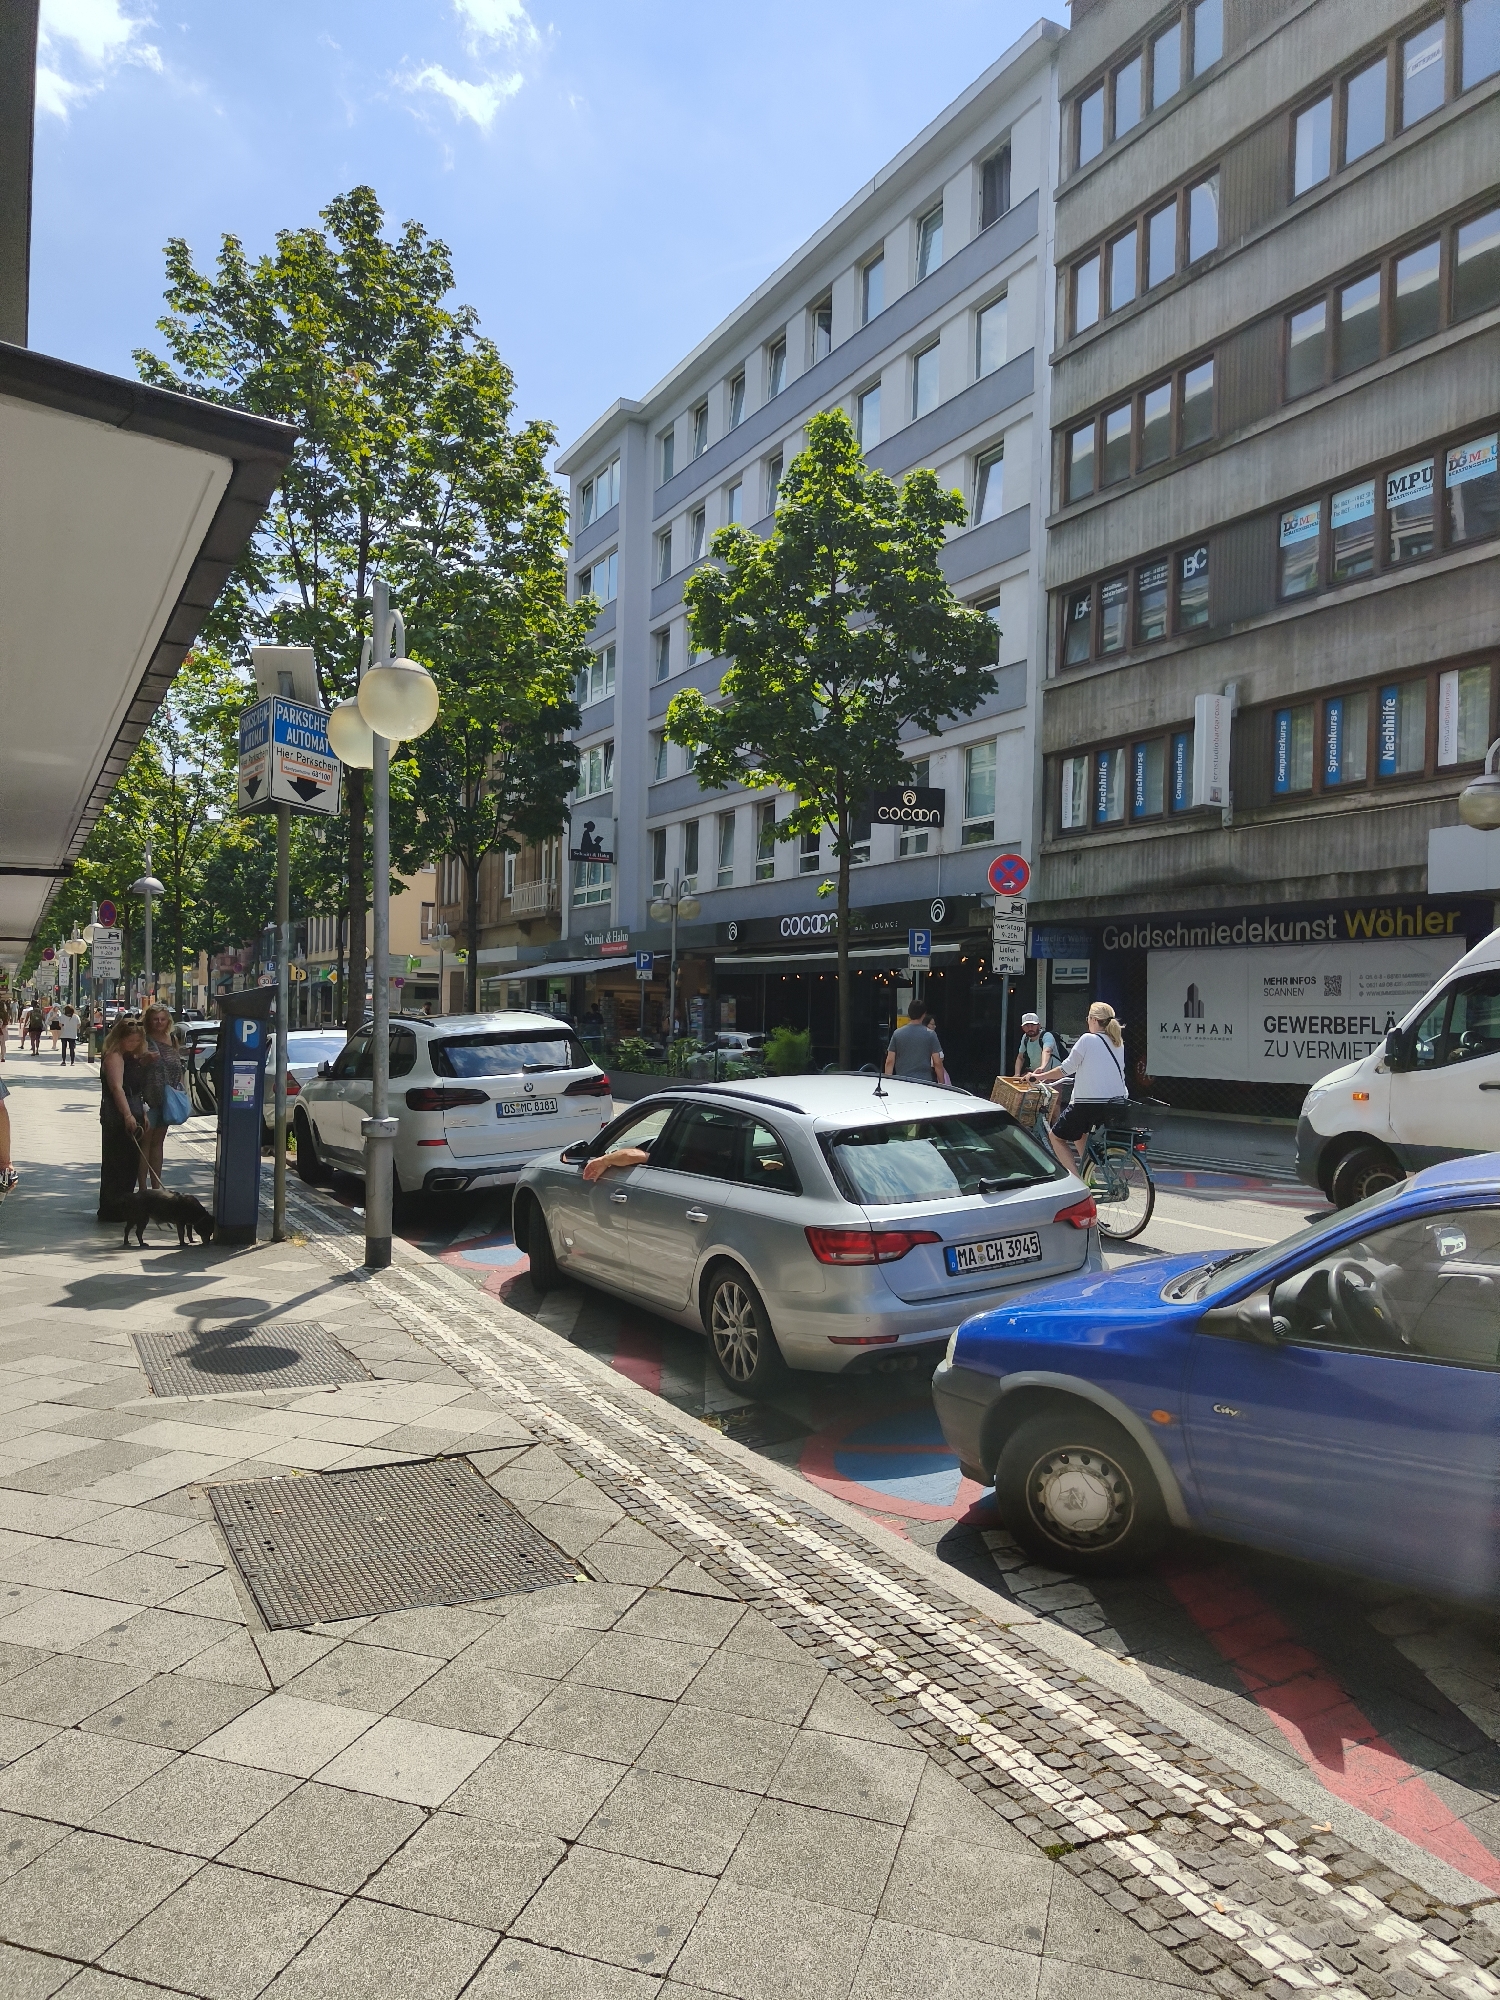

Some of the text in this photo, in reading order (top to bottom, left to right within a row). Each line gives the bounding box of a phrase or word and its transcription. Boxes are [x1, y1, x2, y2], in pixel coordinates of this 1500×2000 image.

[1387, 466, 1434, 497] MPU
[1183, 547, 1207, 579] BC
[286, 726, 330, 754] AUTOMAT
[1327, 709, 1338, 773] Sprachkurse
[1382, 697, 1396, 761] Nachhilfe
[276, 746, 338, 773] Hier Parkschein
[1277, 720, 1287, 782] Computerkurse
[1135, 752, 1144, 807] Sprachkurse
[1175, 743, 1184, 800] Computerkurse
[1098, 761, 1108, 812] Nachhilfe
[877, 806, 941, 823] cocoon
[605, 931, 612, 944] &
[612, 929, 629, 943] Hahn
[995, 923, 1024, 933] werktags
[1102, 904, 1461, 950] Goldschmiedekunst Wöhler
[915, 933, 926, 952] P
[640, 953, 650, 968] P
[1263, 976, 1317, 986] MEHR INFOS
[1263, 987, 1305, 997] SCANNEN
[242, 1020, 257, 1043] P
[1160, 1022, 1233, 1035] KAYHAN
[1264, 1040, 1289, 1058] ZU
[504, 1100, 556, 1115] OS MC 8181
[957, 1236, 1039, 1268] MA CH 3945
[1212, 1404, 1238, 1417] City
